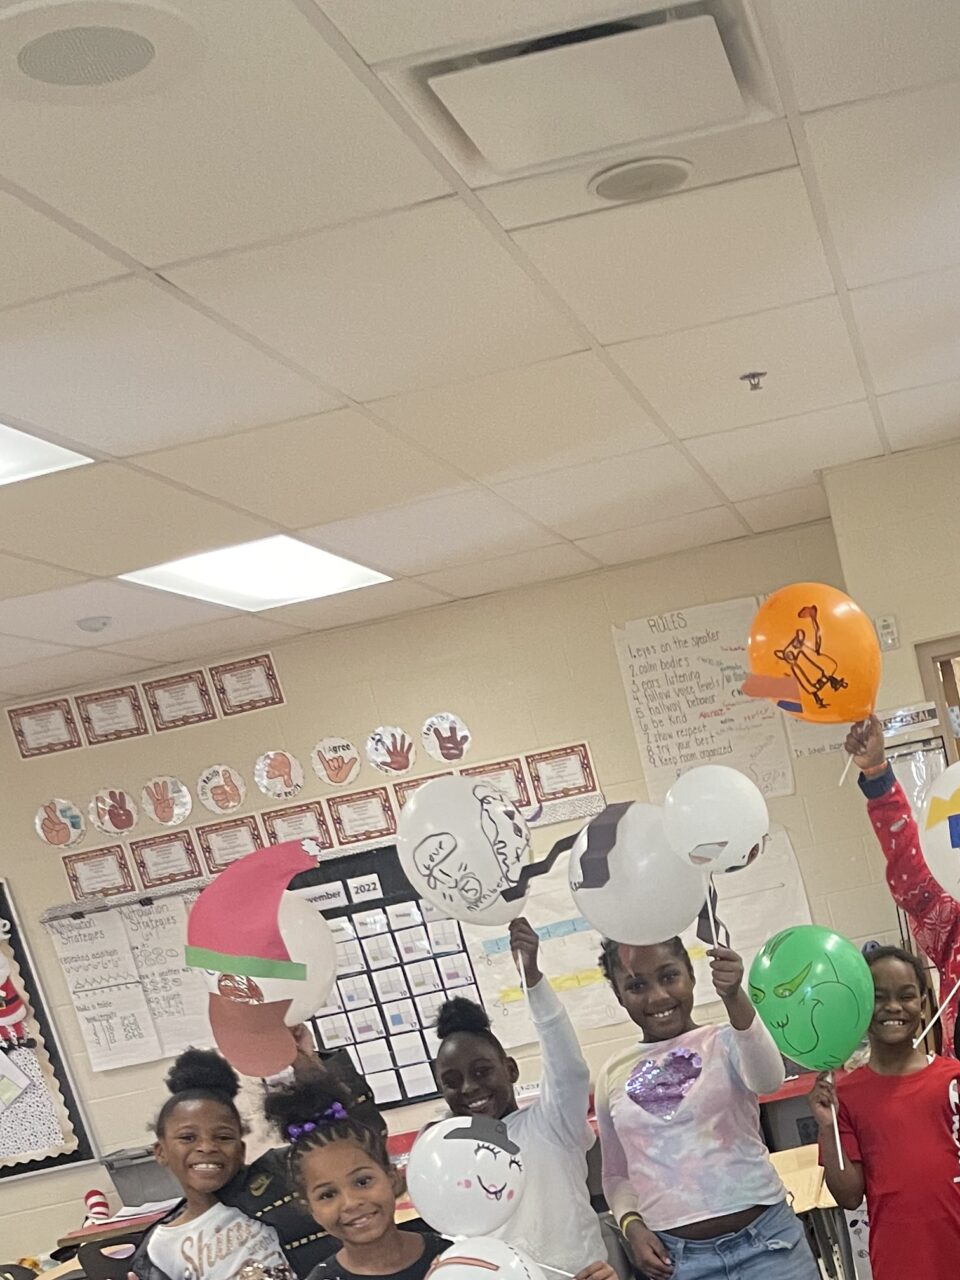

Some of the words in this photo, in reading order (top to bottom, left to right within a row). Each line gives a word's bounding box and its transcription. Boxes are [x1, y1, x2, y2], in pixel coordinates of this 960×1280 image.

[646, 612, 688, 634] RULES
[660, 641, 672, 653] on
[671, 636, 690, 649] the
[691, 628, 721, 648] speaker
[659, 655, 690, 671] bodies
[664, 670, 701, 687] listening
[643, 688, 671, 703] follow
[646, 700, 683, 716] hallway
[651, 717, 664, 729] be
[675, 723, 708, 740] respect
[694, 734, 716, 748] best
[679, 750, 697, 764] room
[700, 740, 734, 762] organized
[305, 889, 342, 904] vember
[353, 881, 379, 896] 2022
